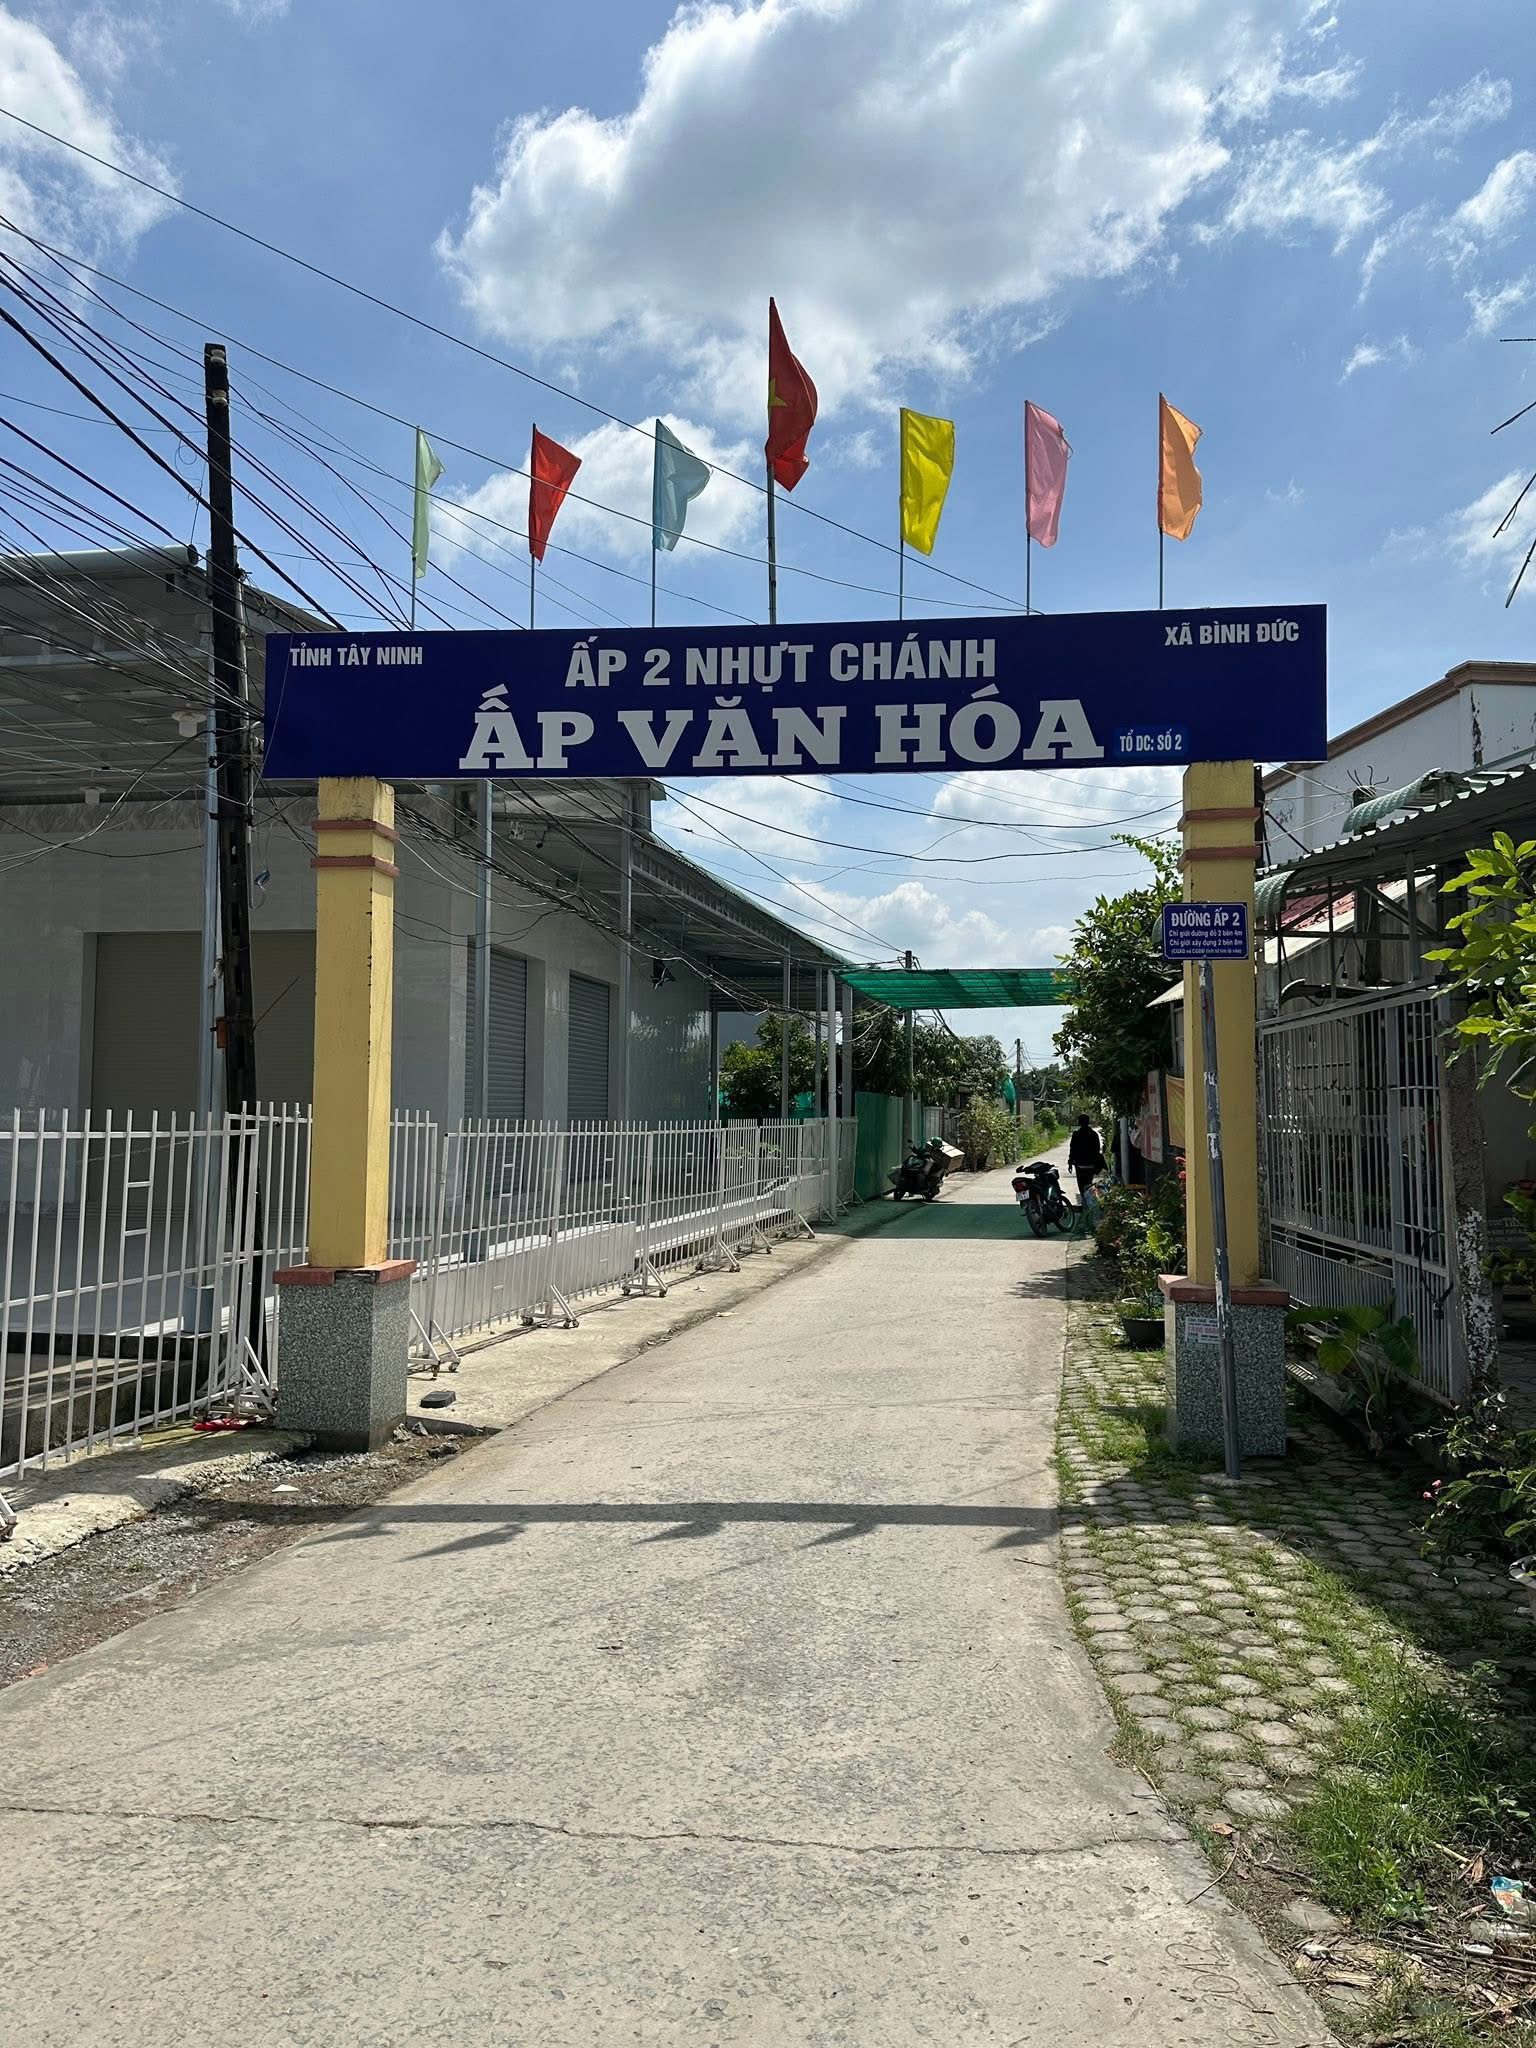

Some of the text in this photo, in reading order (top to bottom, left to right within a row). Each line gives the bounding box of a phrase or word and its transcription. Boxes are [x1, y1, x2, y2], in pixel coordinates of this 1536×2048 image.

[1164, 618, 1299, 646] XÃ BÌNH ĐỨC
[289, 641, 423, 667] TỈNH TÂY NINH
[565, 633, 998, 692] ẤP 2 NHỰT CHÁNH
[459, 683, 1105, 769] ẤP VĂN HÓA
[1119, 728, 1182, 752] TỔ DC: SỐ 2
[1171, 907, 1240, 927] ĐƯỜNG ẤP 2
